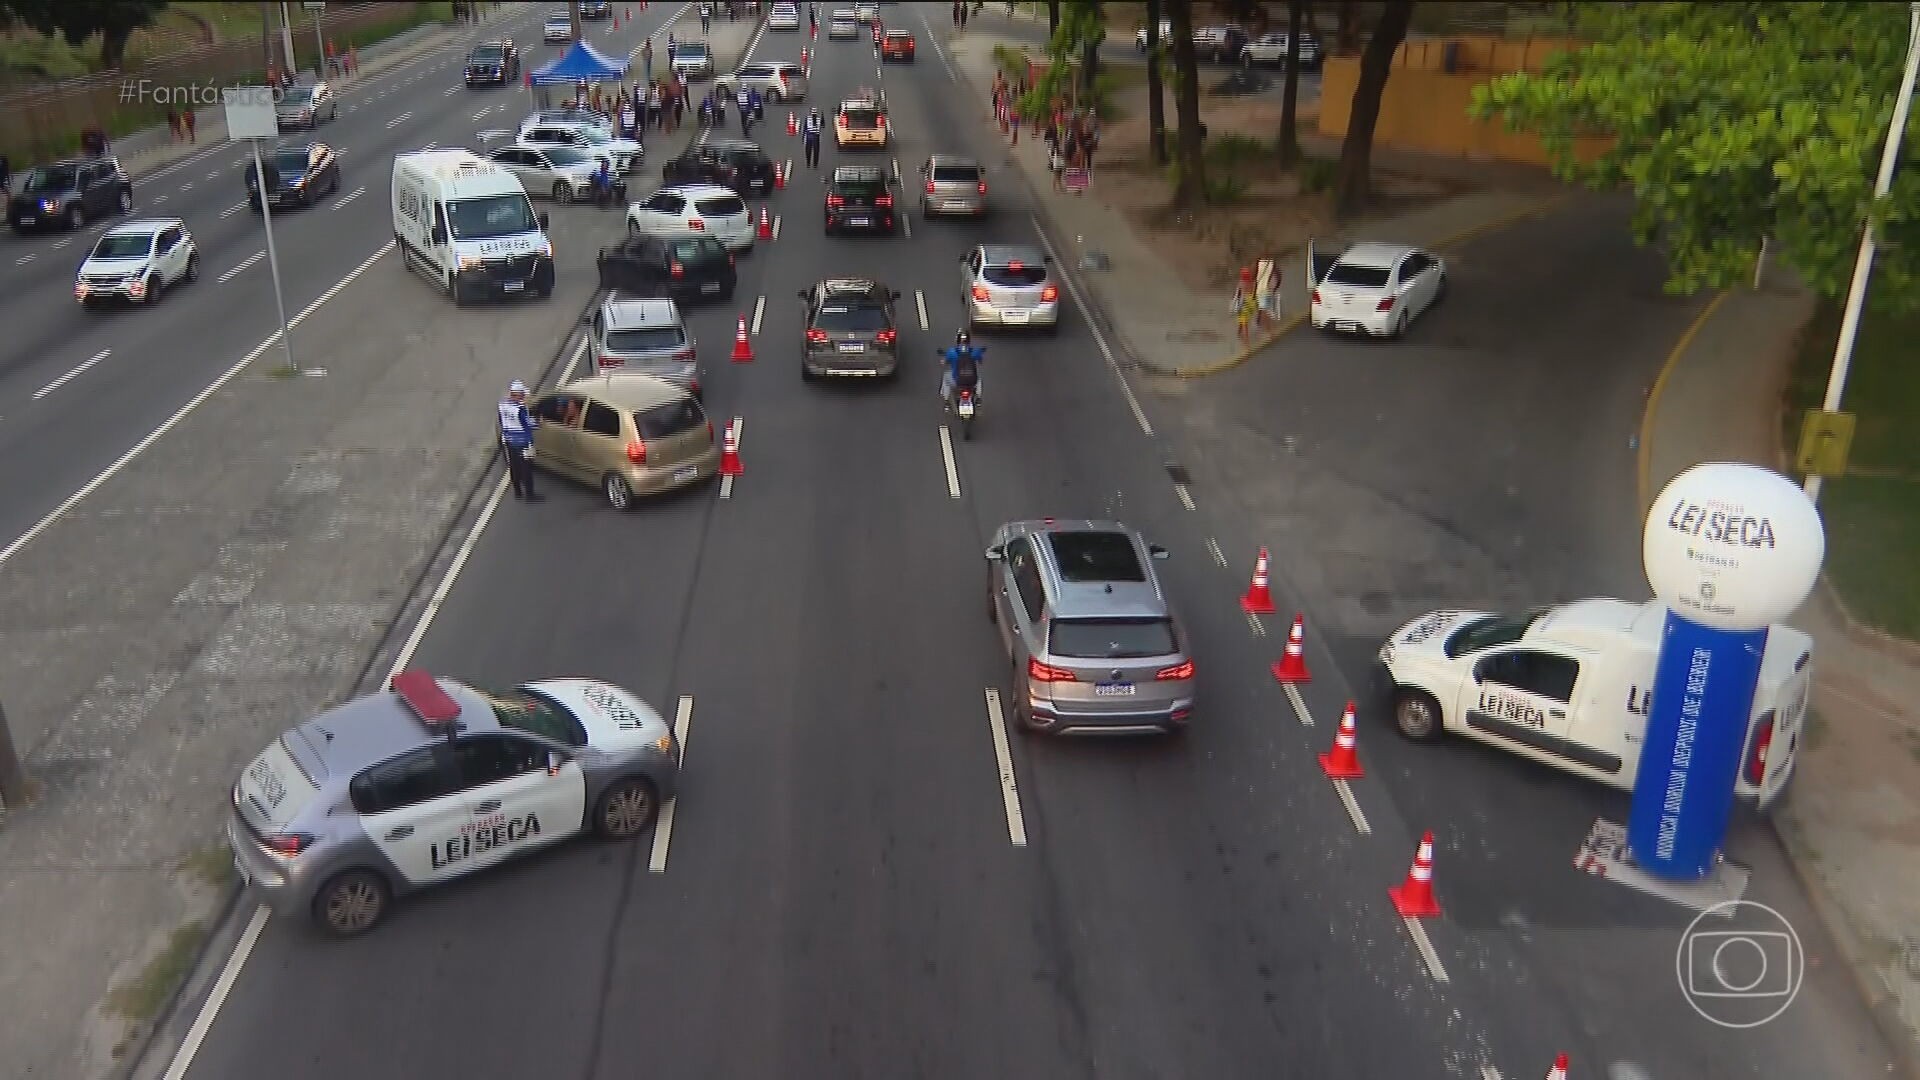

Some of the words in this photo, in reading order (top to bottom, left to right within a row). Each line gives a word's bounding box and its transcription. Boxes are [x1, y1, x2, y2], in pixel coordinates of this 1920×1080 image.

[1667, 499, 1707, 535] LEI
[1705, 510, 1775, 548] SECA
[1687, 647, 1713, 694] BEBER
[1478, 692, 1502, 715] LEI
[1504, 699, 1545, 729] SECA
[1684, 694, 1703, 717] DE
[1673, 717, 1697, 767] DEPOIS
[1664, 768, 1687, 815] DIRIJA
[430, 833, 471, 870] LEI
[475, 812, 542, 853] SECA
[1655, 814, 1678, 861] NUNCA
